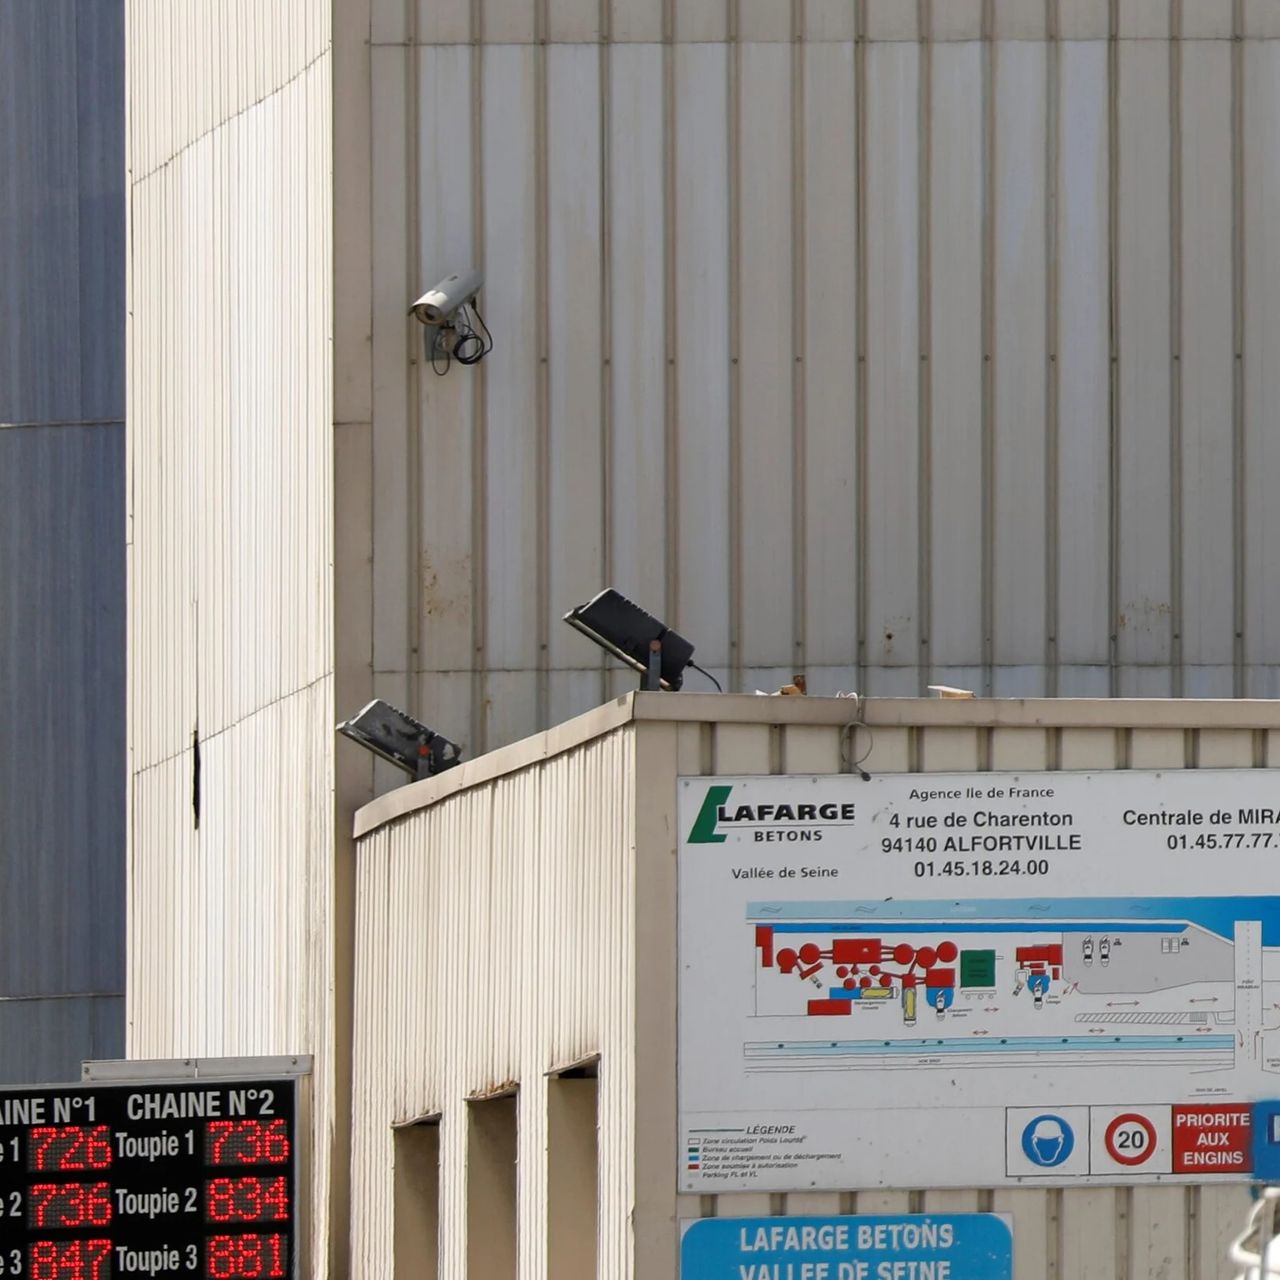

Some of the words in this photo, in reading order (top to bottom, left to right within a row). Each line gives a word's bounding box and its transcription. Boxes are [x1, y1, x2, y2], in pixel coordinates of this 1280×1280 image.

[909, 788, 962, 802] Agence
[966, 787, 983, 799] Ile
[987, 787, 1005, 799] de
[1009, 786, 1055, 798] France
[718, 803, 855, 822] LAFARGE
[889, 813, 900, 828] 4
[906, 816, 938, 828] rue
[943, 812, 968, 828] de
[973, 811, 1073, 827] Charenton
[1122, 809, 1203, 826] Centrale
[1209, 809, 1232, 825] de
[754, 830, 823, 842] BETONS
[881, 837, 937, 853] 94140
[943, 835, 1082, 852] ALFORTVILLE
[732, 867, 775, 879] Vallée
[779, 867, 796, 879] de
[801, 866, 839, 879] Seine
[914, 859, 1049, 877] 01.45.18.24.00
[0, 1098, 46, 1125] INE
[53, 1095, 96, 1123] N°1
[127, 1090, 221, 1120] CHAINE
[229, 1088, 275, 1116] N°2
[1176, 1112, 1250, 1128] PRIORITE
[10, 1136, 20, 1162] 1
[31, 1125, 113, 1170] 726
[115, 1130, 179, 1162] Toupie
[185, 1129, 195, 1155] 1
[207, 1119, 290, 1164] 736
[1118, 1130, 1144, 1148] 20
[1197, 1132, 1230, 1146] AUX
[1183, 1151, 1244, 1166] ENGINS
[9, 1191, 22, 1217] 2
[31, 1182, 113, 1227] 736
[115, 1188, 179, 1220] Toupie
[184, 1187, 198, 1213] 2
[208, 1176, 290, 1221] 834
[740, 1225, 849, 1251] LAFARGE
[857, 1223, 954, 1250] BETONS
[10, 1249, 22, 1275] 3
[31, 1239, 113, 1280] 847
[115, 1245, 179, 1277] Toupie
[184, 1244, 198, 1270] 3
[208, 1233, 284, 1279] 881
